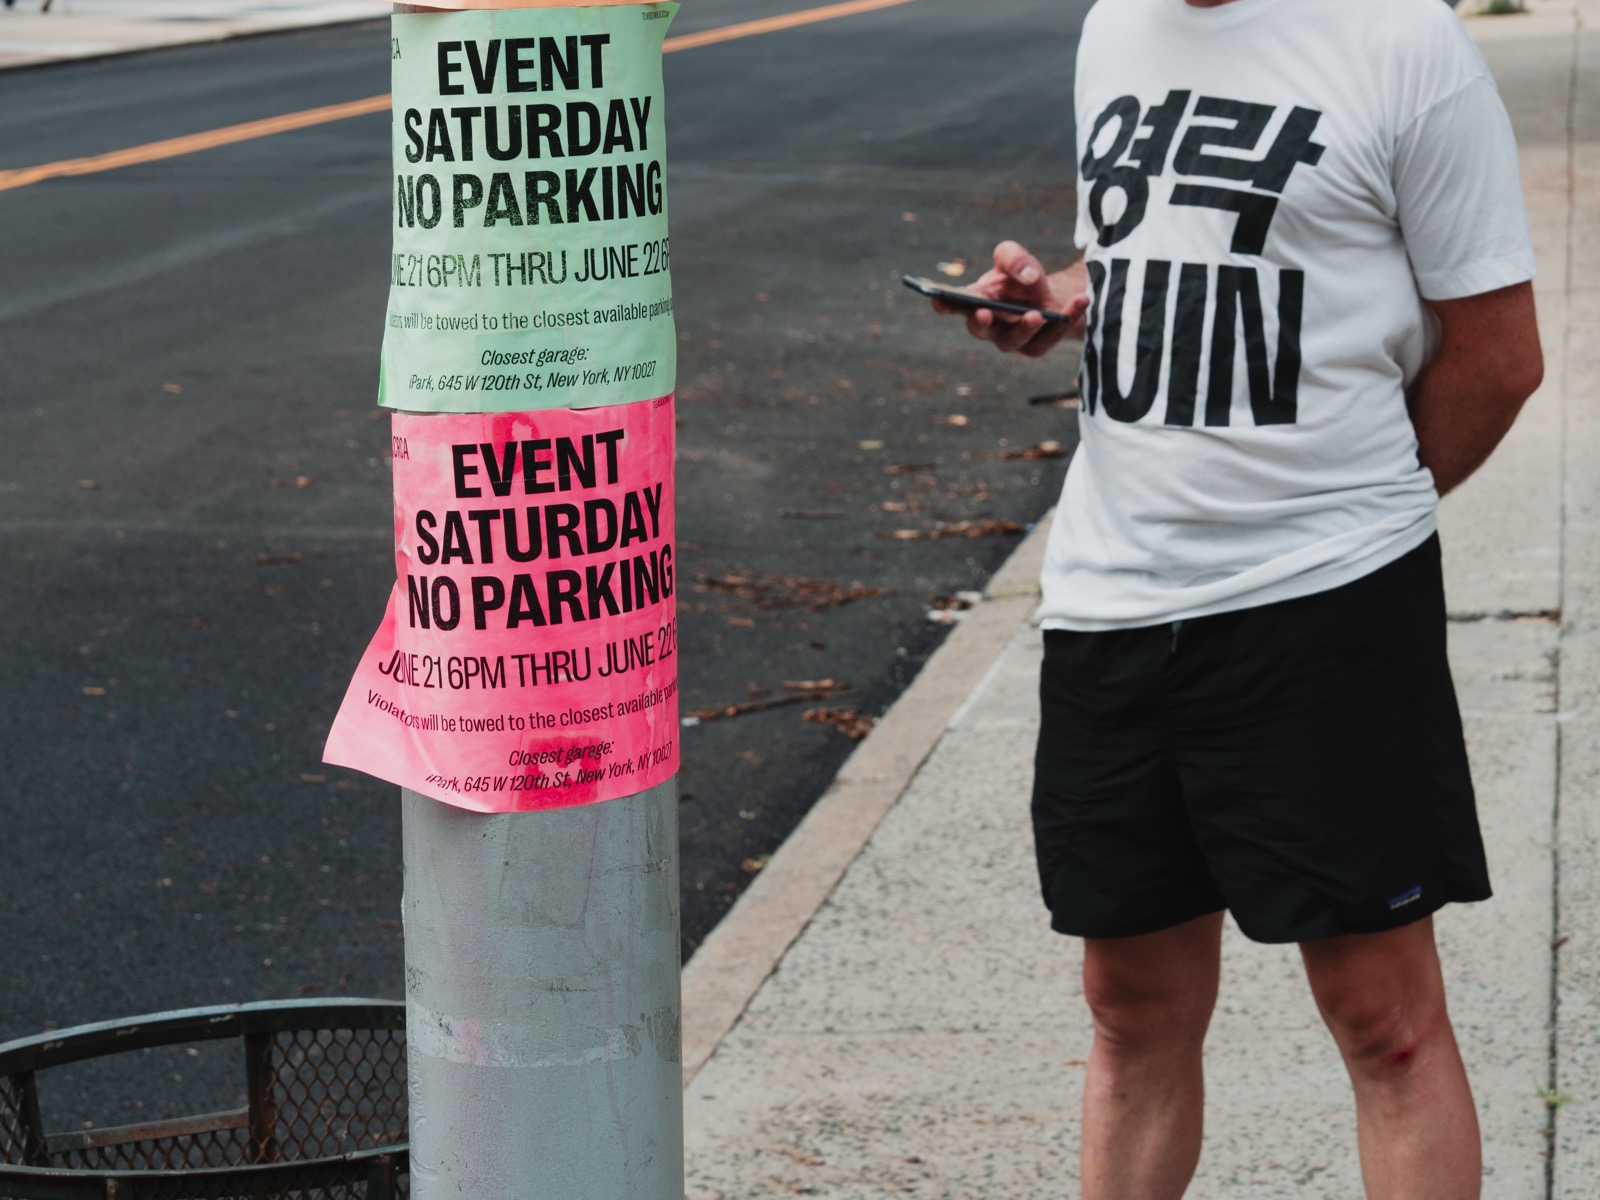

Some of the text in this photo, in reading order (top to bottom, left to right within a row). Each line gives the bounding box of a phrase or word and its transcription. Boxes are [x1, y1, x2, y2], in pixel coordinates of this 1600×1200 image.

[438, 34, 610, 95] EVENT
[404, 96, 651, 163] SATURDAY
[398, 160, 662, 229] NO PARKING
[1081, 90, 1326, 256] 영락
[408, 254, 423, 287] 21
[427, 254, 481, 288] 6PM
[487, 250, 566, 287] THRU
[575, 243, 639, 282] JUNE
[643, 241, 661, 275] 22
[404, 313, 418, 329] will
[421, 313, 433, 330] be
[436, 313, 478, 330] towed
[482, 314, 498, 330] to
[502, 312, 528, 330] the
[533, 310, 590, 328] closest
[593, 302, 648, 325] available
[650, 297, 670, 322] parking
[409, 360, 656, 393] iPark, 645 W 120th St, New York, NY 10027
[481, 346, 590, 368] Closest garage:
[452, 429, 625, 498] EVENT
[415, 482, 663, 565] SATURDAY
[407, 543, 673, 631] NO PARKING
[378, 650, 420, 687] JUNE
[422, 655, 443, 688] 21
[447, 655, 506, 690] 6PM
[512, 648, 590, 688] THRU
[598, 631, 655, 677] JUNE
[658, 626, 672, 661] 22
[367, 689, 420, 730] Violators
[421, 714, 439, 731] will
[441, 715, 456, 732] be
[459, 714, 504, 732] towed
[508, 714, 525, 731] to
[529, 709, 557, 729] the
[560, 702, 614, 727] closest
[617, 687, 663, 717] available
[425, 741, 672, 793] iPark, 645 W 120th St, New York, NY 10027
[508, 739, 615, 768] Closest garage:
